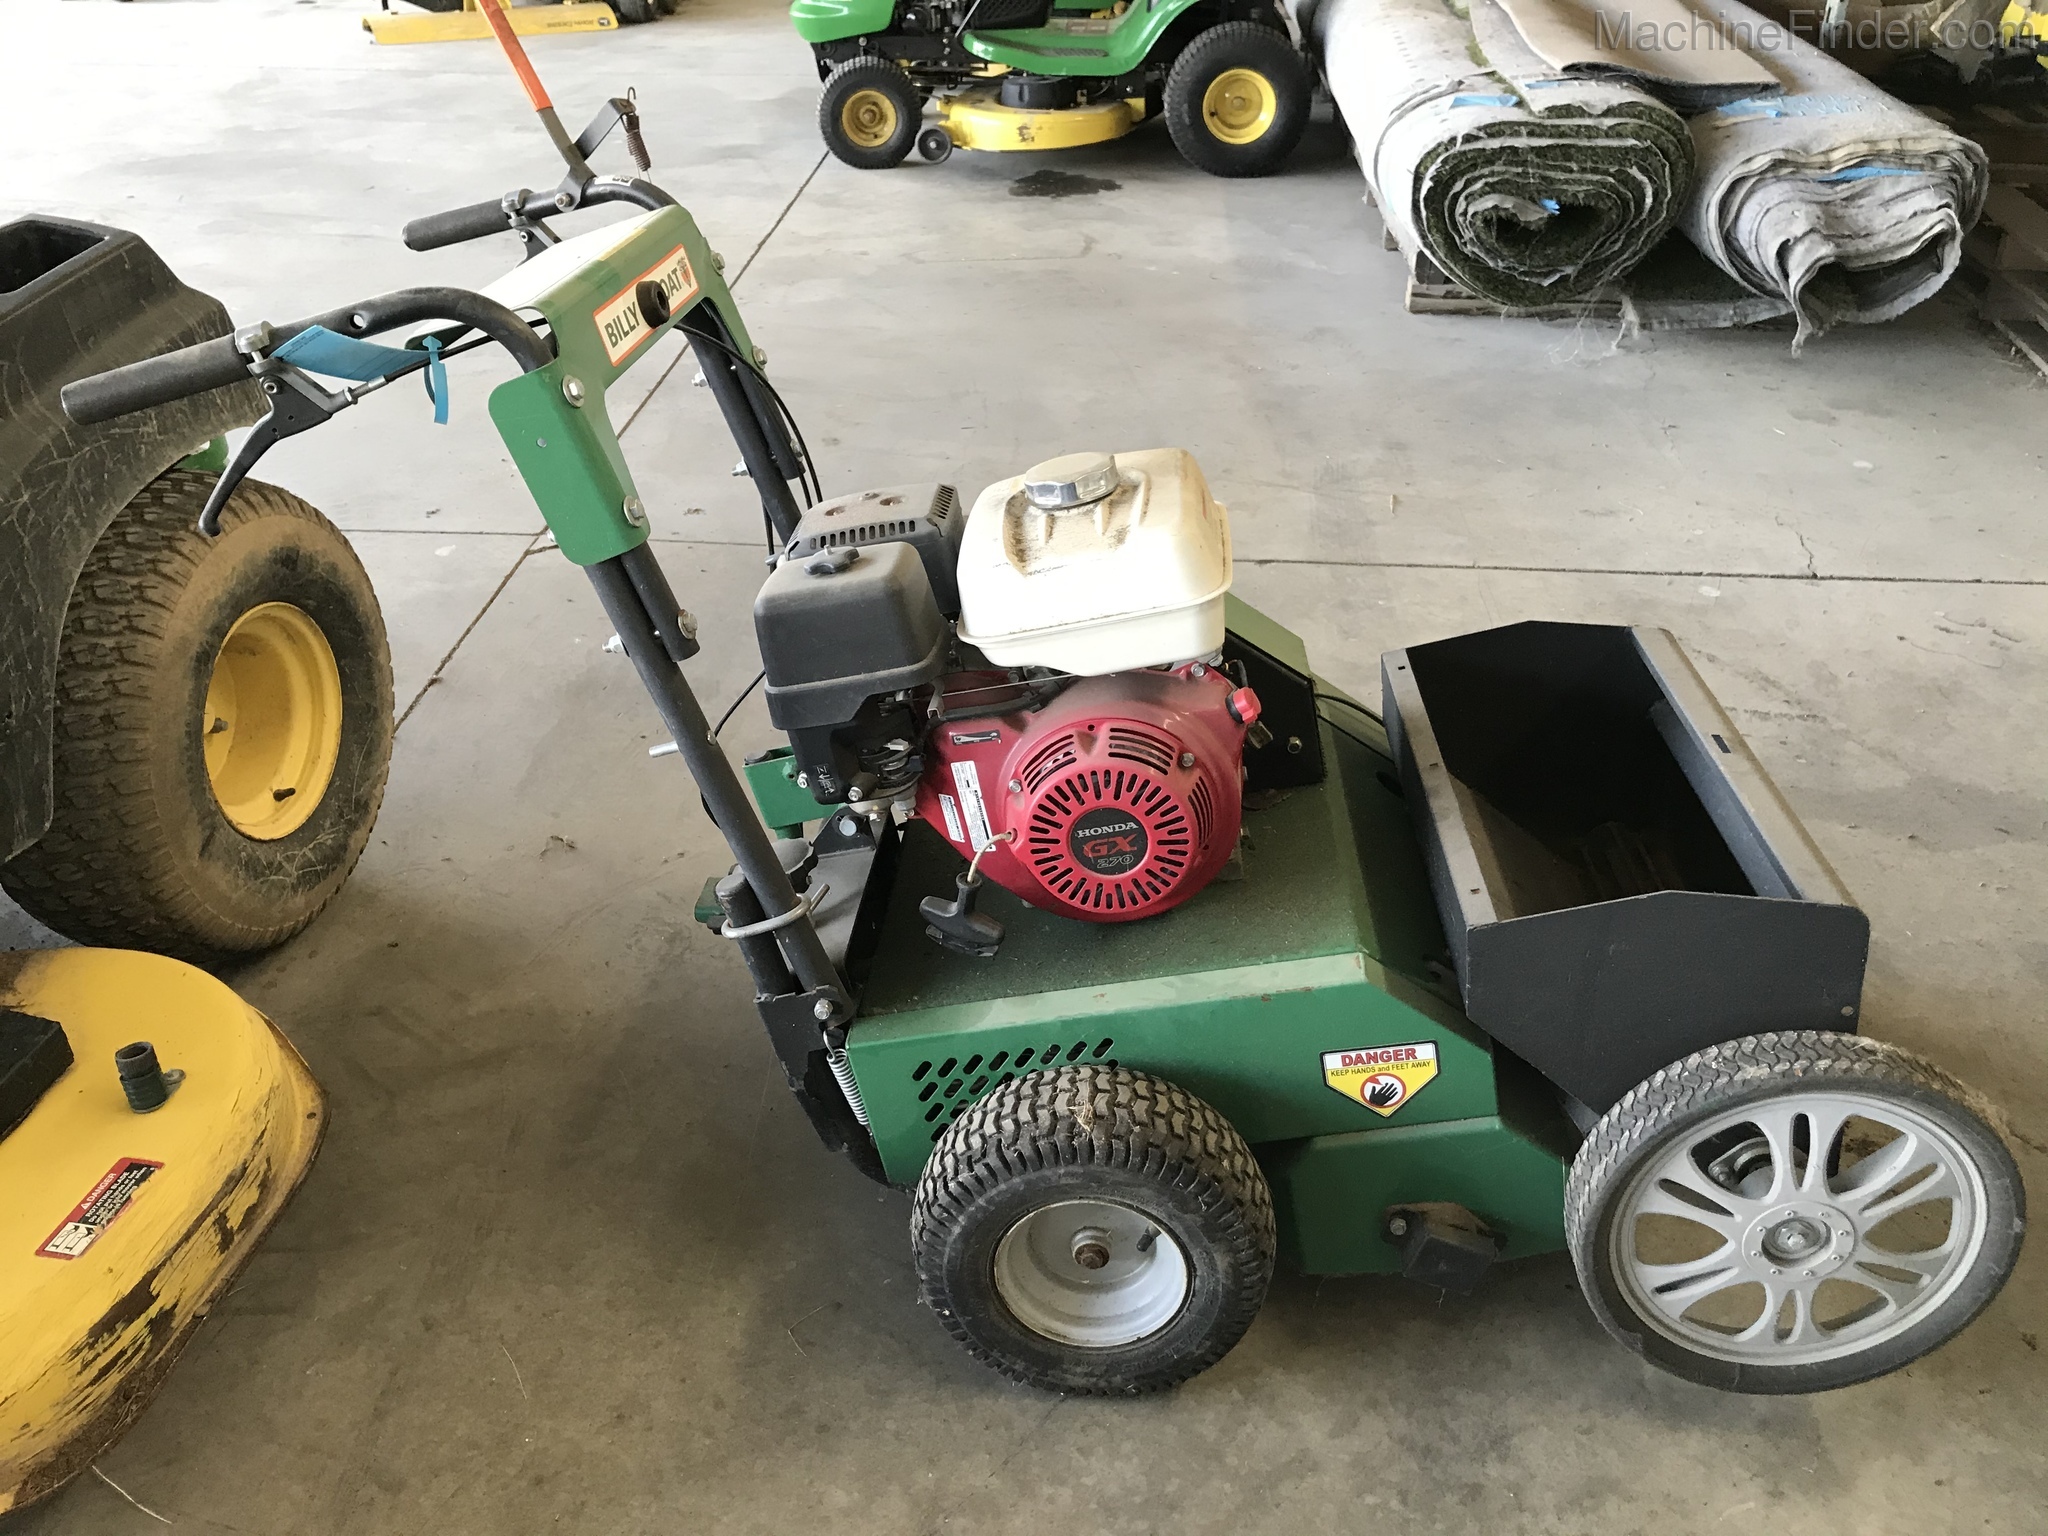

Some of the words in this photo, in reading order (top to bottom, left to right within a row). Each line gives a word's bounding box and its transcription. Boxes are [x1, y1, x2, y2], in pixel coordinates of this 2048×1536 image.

[604, 301, 640, 349] BILLY
[659, 267, 682, 301] OAT
[1077, 821, 1139, 838] HONDA
[1083, 833, 1137, 858] GX
[1097, 854, 1134, 869] 270
[1331, 1069, 1349, 1077] KEEP
[1351, 1066, 1376, 1075] HANDS
[1377, 1065, 1390, 1073] and
[1391, 1062, 1410, 1070] FEET
[1411, 1060, 1431, 1068] AWAY
[1341, 1048, 1417, 1067] DANGER
[84, 1189, 114, 1216] ROTATING
[110, 1171, 130, 1189] BLADE
[85, 1172, 117, 1201] DANGER
